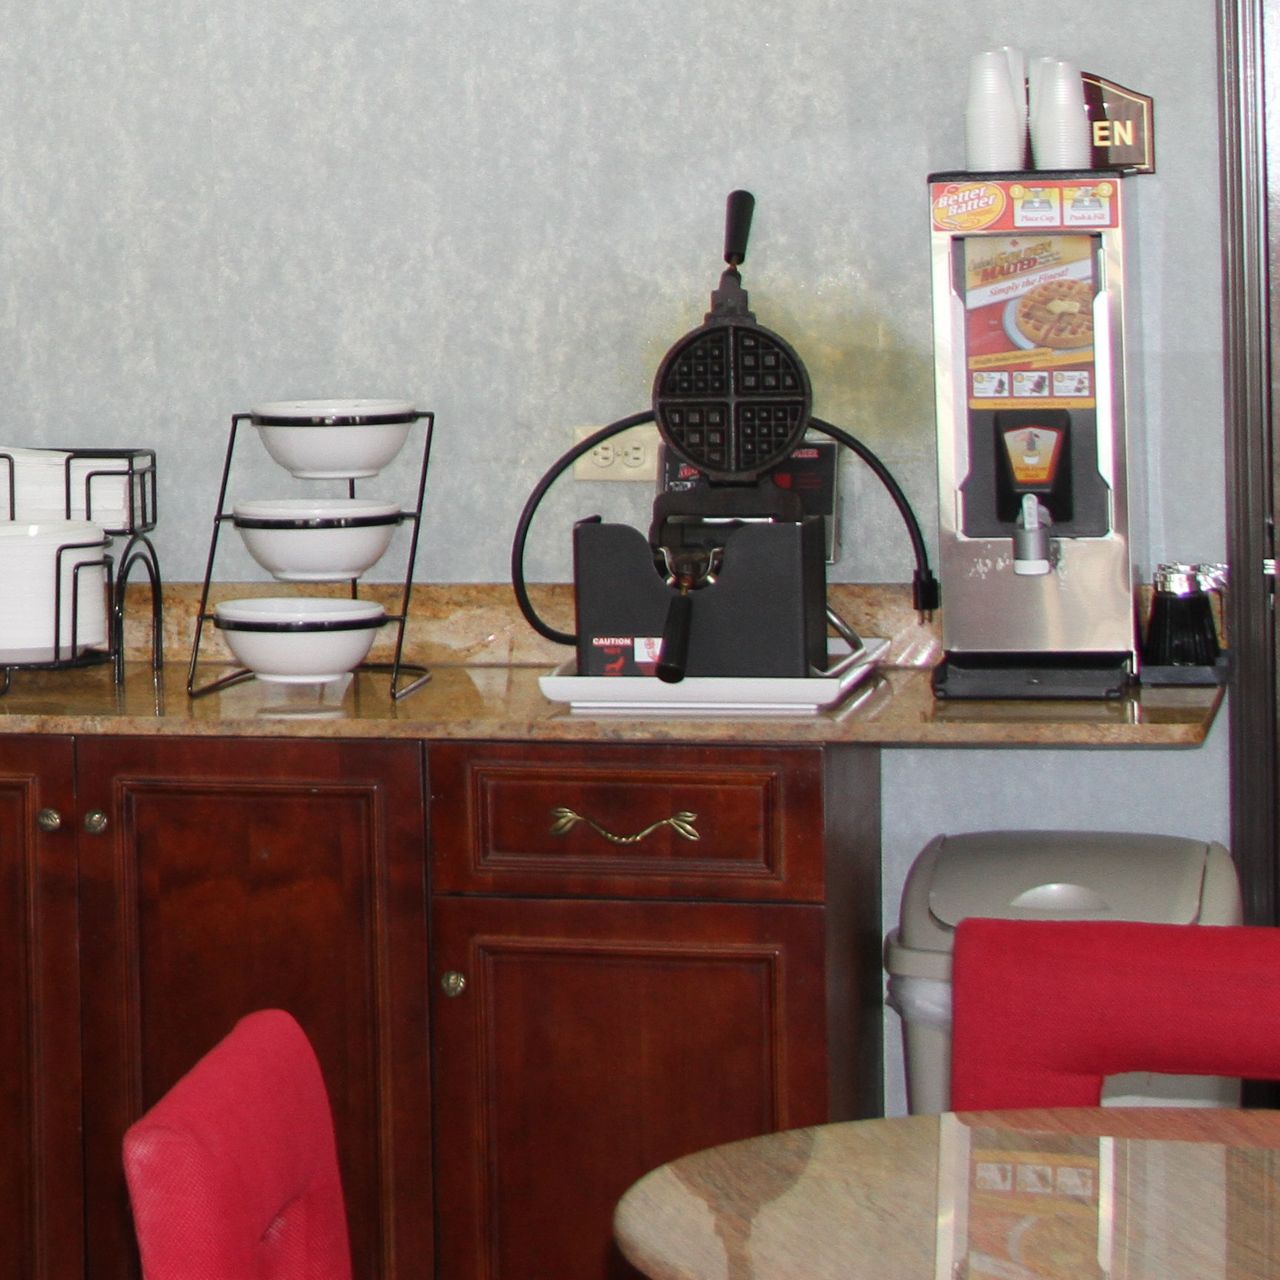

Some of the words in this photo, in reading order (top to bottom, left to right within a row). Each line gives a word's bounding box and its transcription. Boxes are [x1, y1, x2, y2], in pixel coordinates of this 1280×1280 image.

[939, 187, 986, 208] Better
[948, 195, 996, 216] Batter
[592, 637, 631, 645] CAUTION
